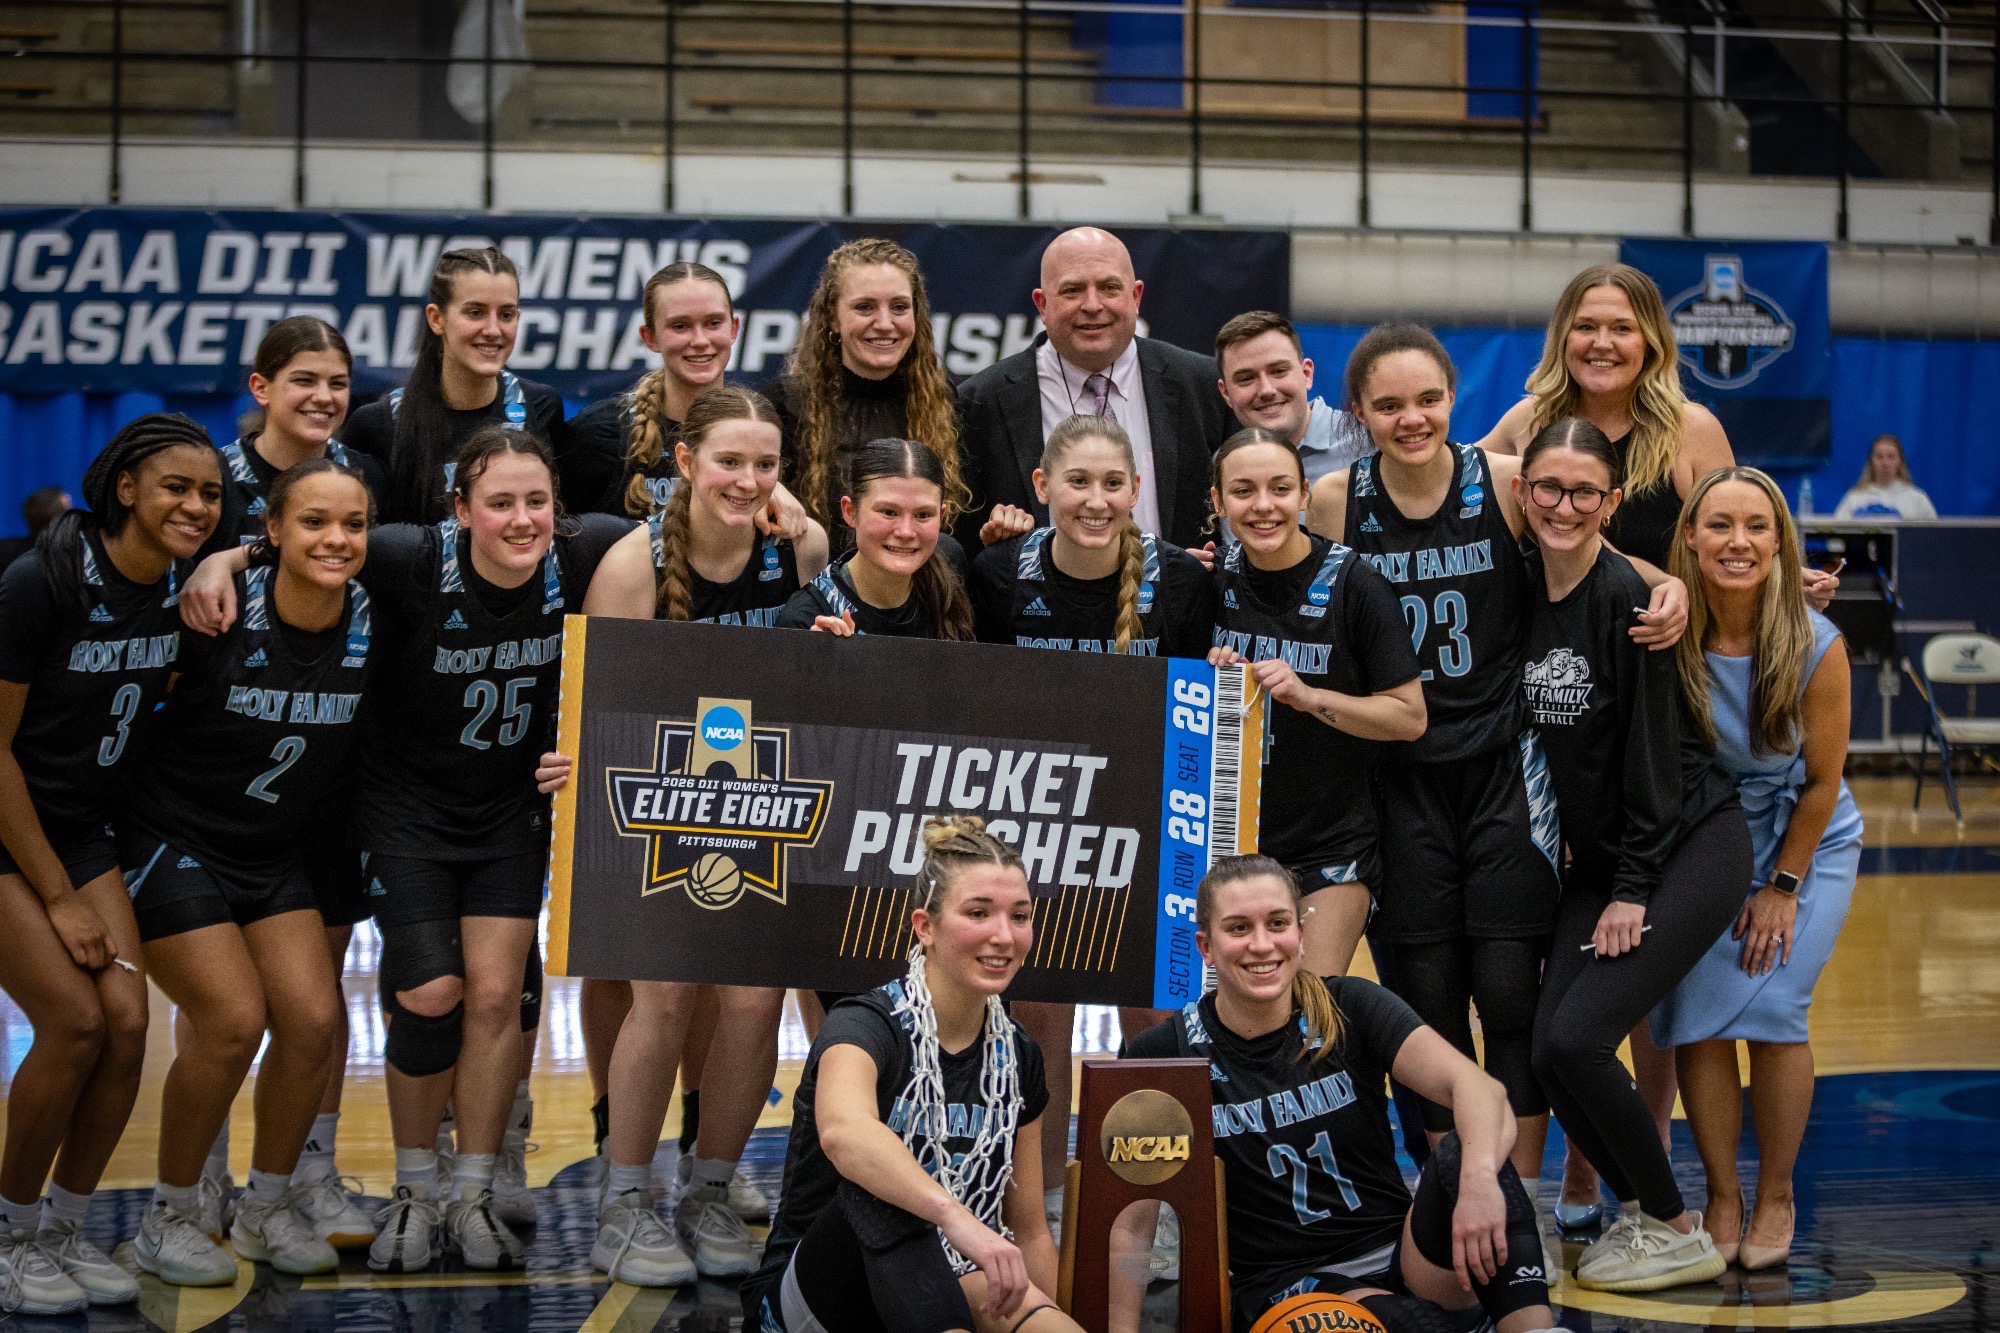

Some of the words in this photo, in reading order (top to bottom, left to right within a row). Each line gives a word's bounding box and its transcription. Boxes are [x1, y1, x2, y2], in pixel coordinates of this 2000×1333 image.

[197, 230, 348, 296] DII
[366, 234, 751, 301] WMEN'S
[1416, 539, 1494, 580] FAMILY
[1023, 608, 1051, 616] adidas
[1310, 592, 1329, 601] NCAA
[67, 640, 128, 673] HOLY
[433, 645, 492, 674] HOLY
[494, 633, 562, 670] FAMIL
[1253, 636, 1332, 674] FAMILY
[225, 685, 290, 723] HOLY
[289, 692, 363, 724] FAMILY
[460, 677, 537, 750] 25
[1173, 678, 1210, 736] 26
[1540, 687, 1586, 703] FAMILY
[97, 683, 141, 766] 3
[705, 727, 744, 740] NCAA
[245, 736, 307, 803] 2
[896, 743, 1108, 816] TICKET
[1178, 742, 1199, 783] SEAT
[662, 778, 694, 788] 2026
[698, 780, 719, 789] DII
[722, 782, 779, 793] WOMEN'S
[632, 788, 716, 822] ELITE
[720, 793, 812, 829] EIGHT
[1168, 789, 1206, 846] 28
[678, 836, 757, 850] PITTSBURGH
[1174, 850, 1194, 889] ROW
[1165, 893, 1197, 923] 3
[1169, 926, 1191, 998] SECTION
[1211, 1098, 1267, 1138] HOLY
[1267, 1070, 1357, 1128] FAMILY
[1110, 1135, 1190, 1162] NCAA
[1267, 1131, 1362, 1225] 21
